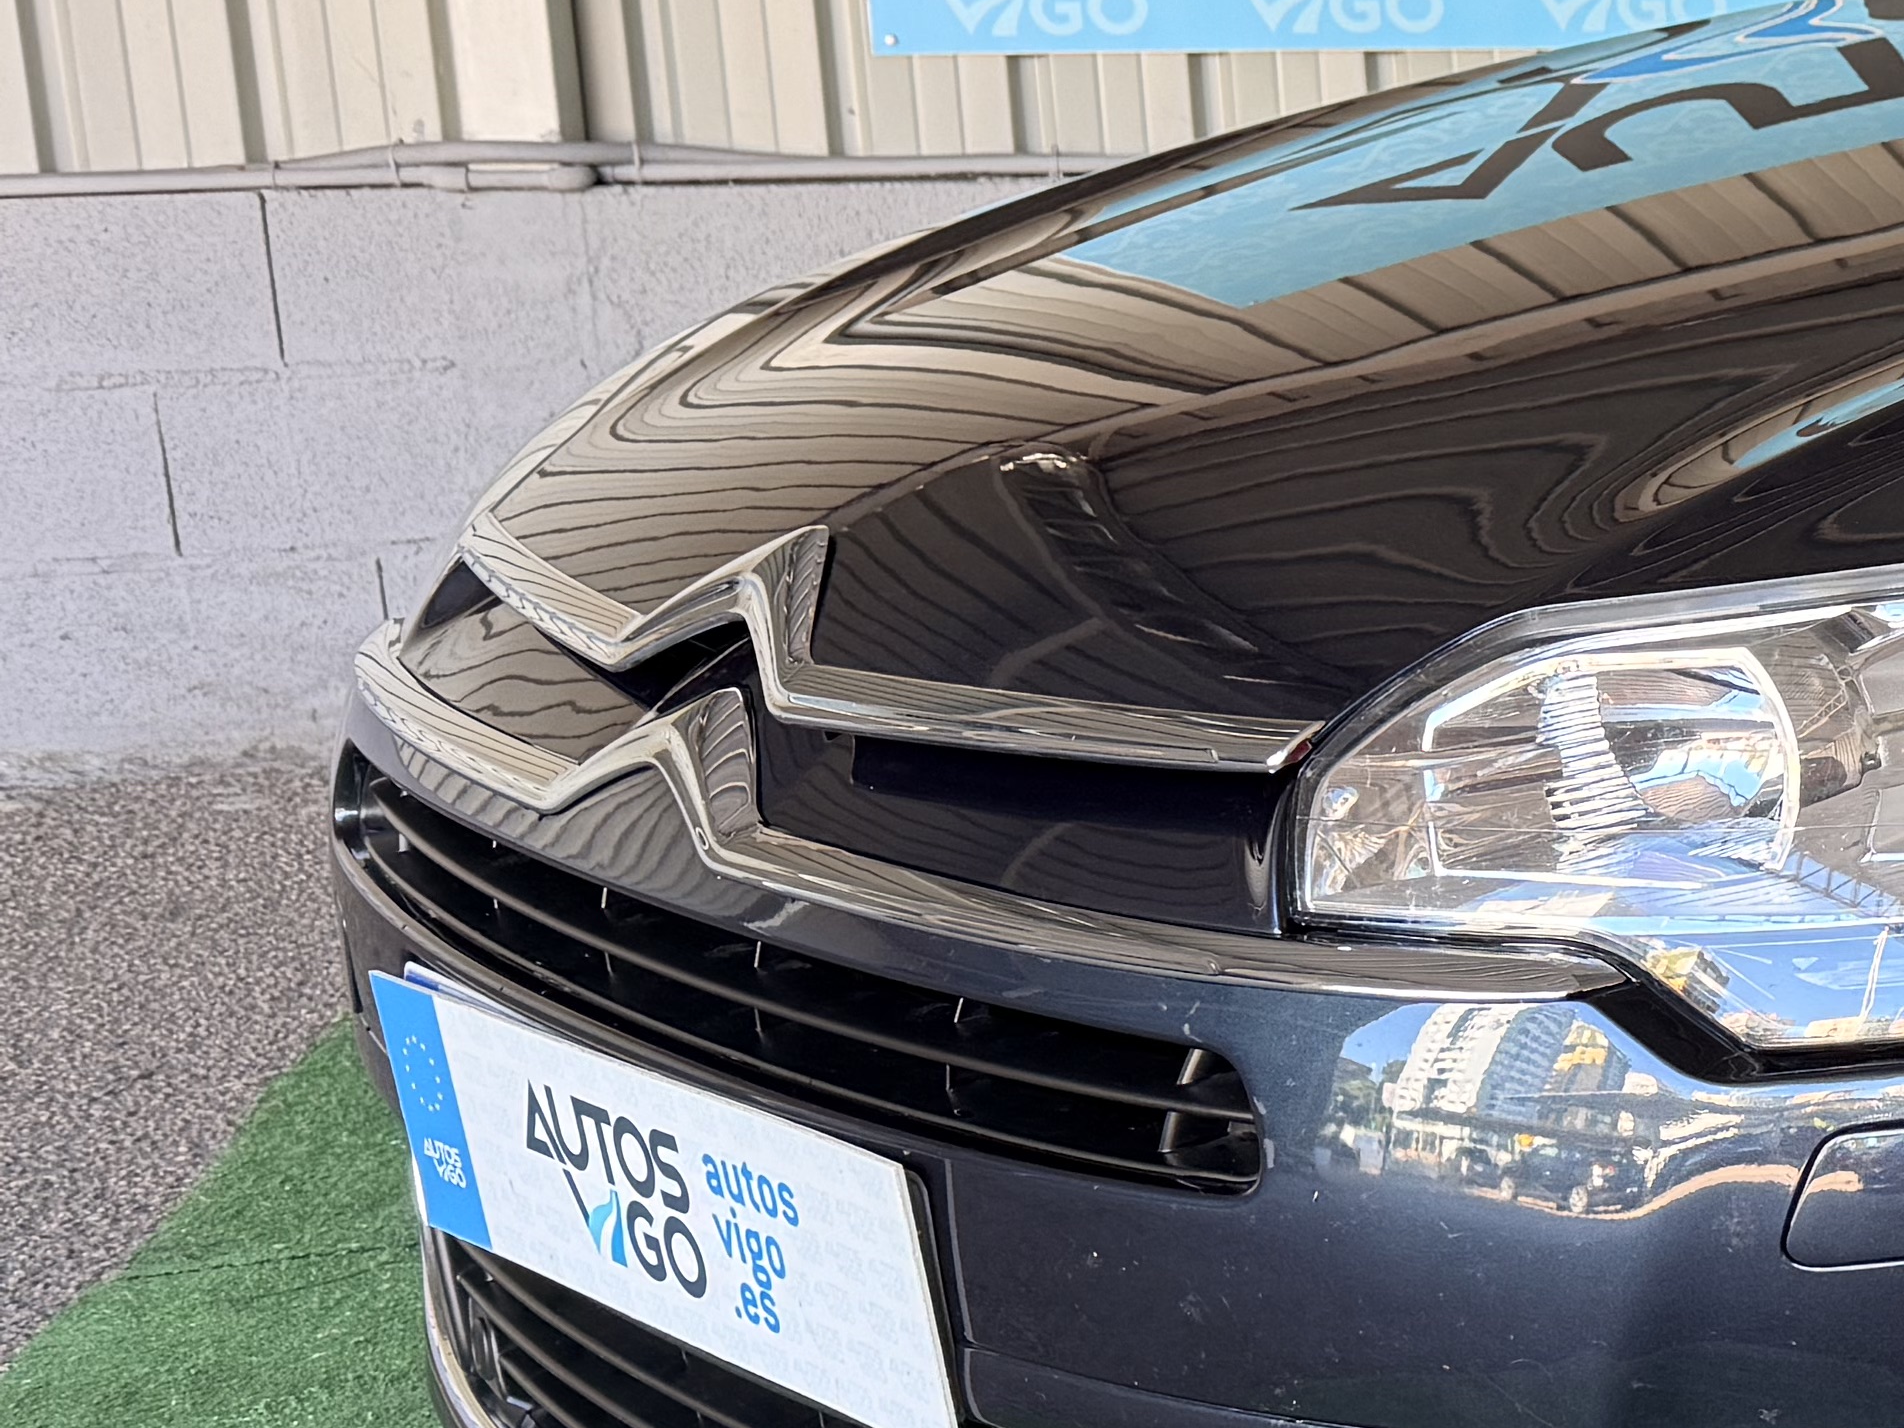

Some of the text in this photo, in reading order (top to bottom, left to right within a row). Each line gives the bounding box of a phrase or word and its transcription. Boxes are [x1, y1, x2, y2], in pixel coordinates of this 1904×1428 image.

[424, 1137, 462, 1168] AUTOS
[433, 1157, 467, 1189] VIGO
[526, 1078, 690, 1215] AUTOS
[702, 1153, 799, 1228] autos
[562, 1167, 707, 1299] VIGO
[712, 1206, 786, 1291] vigo
[735, 1282, 780, 1334] .es
